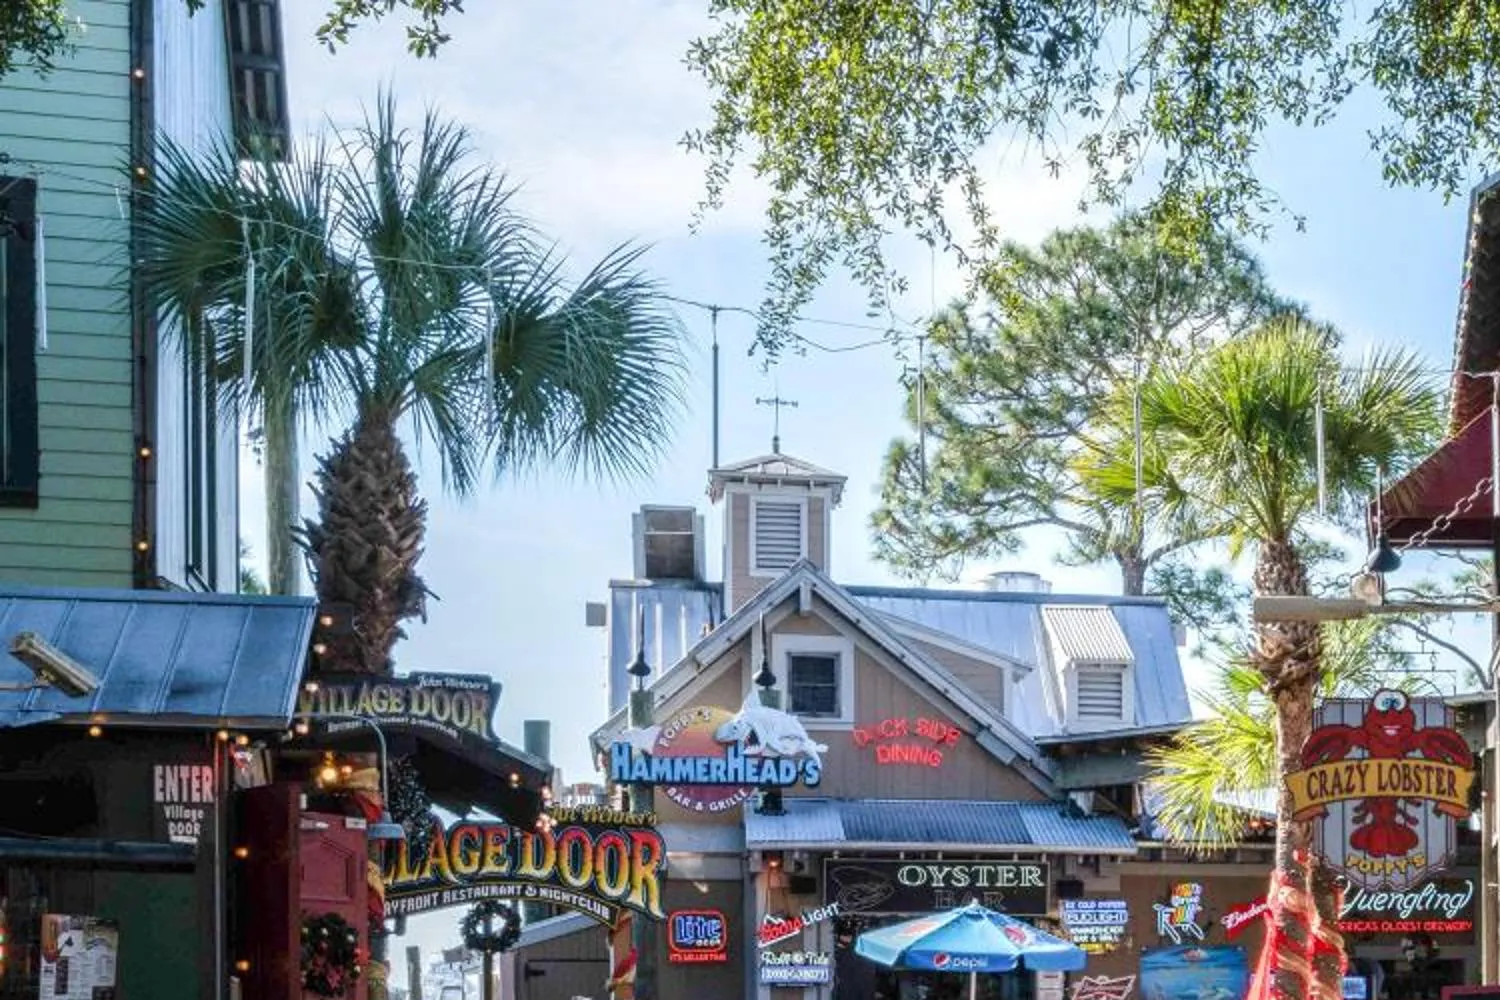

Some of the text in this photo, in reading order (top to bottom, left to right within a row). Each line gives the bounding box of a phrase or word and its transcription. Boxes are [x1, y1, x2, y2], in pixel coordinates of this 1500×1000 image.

[410, 686, 491, 740] DOOR
[853, 719, 908, 748] DCK
[876, 744, 943, 767] DINING
[153, 764, 214, 803] ENTER
[1306, 763, 1458, 800] CRAZY LOBSTER
[667, 788, 690, 807] BAR
[168, 821, 201, 835] DOOR
[382, 820, 665, 920] LLAGE DOOR
[897, 865, 1045, 888] OYSTER
[384, 892, 439, 917] AYFRONT
[443, 885, 522, 904] RESTAURANT
[539, 889, 610, 920] NIGHTCLUB
[1335, 875, 1474, 920] Yuengling
[801, 902, 839, 926] LIGHT
[1339, 920, 1379, 933] ERICAS
[952, 956, 988, 968] pepsi
